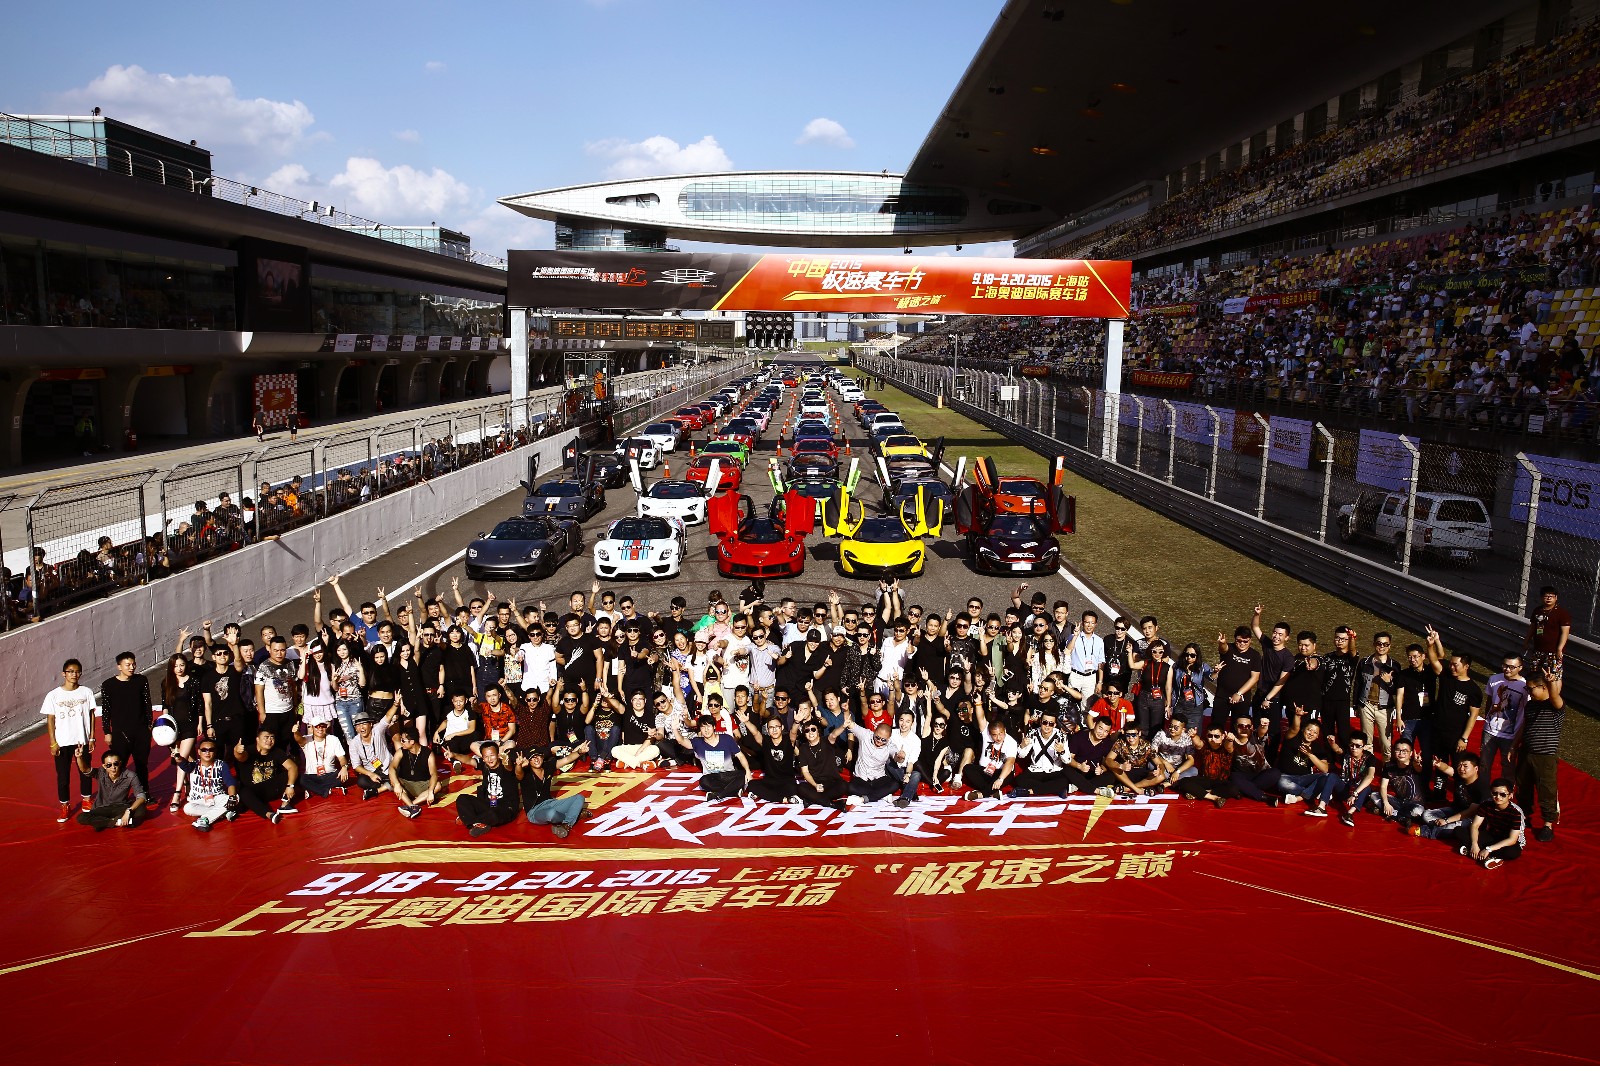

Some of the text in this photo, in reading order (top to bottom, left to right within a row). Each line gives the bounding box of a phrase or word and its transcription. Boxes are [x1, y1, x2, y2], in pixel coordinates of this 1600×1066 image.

[787, 259, 830, 278] 中国
[830, 260, 864, 270] 2015
[821, 265, 926, 292] 极速赛车节
[1054, 274, 1090, 288] 上海站
[971, 286, 1088, 302] 上海奥迪国际赛车场
[583, 793, 1179, 844] 极速赛车节
[718, 864, 857, 885] 上海站
[182, 881, 842, 937] 上海奥迪国际赛车场
